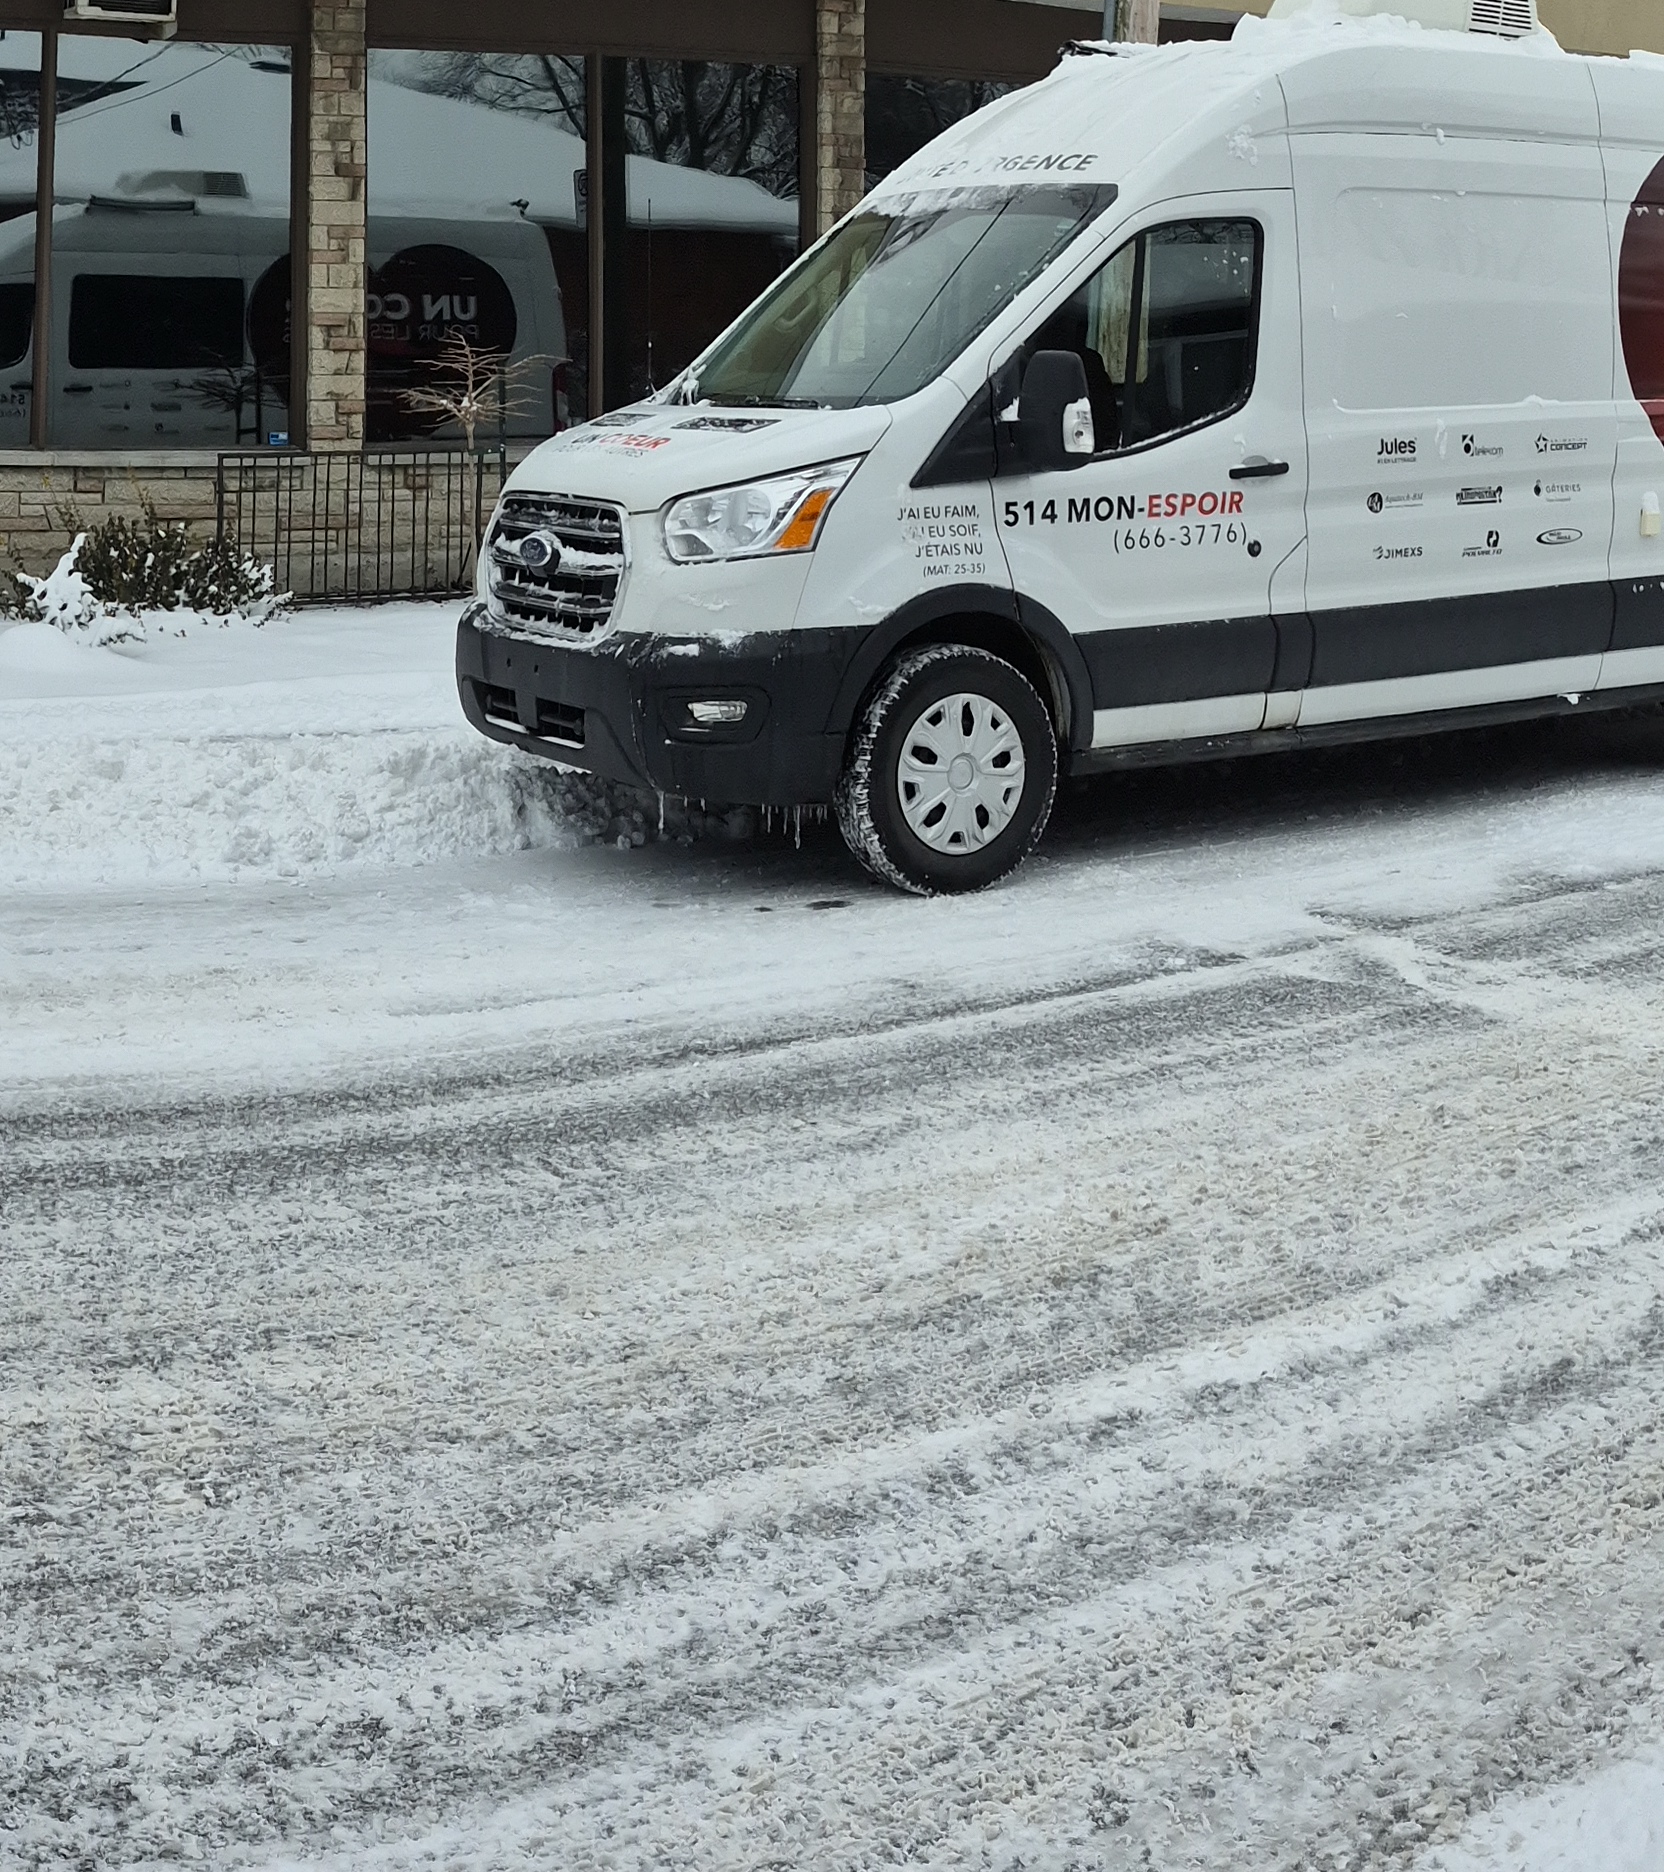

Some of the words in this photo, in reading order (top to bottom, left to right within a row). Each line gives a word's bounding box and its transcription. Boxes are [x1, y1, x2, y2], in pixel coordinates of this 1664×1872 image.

[1377, 437, 1416, 455] Jules
[897, 507, 920, 521] J'AI
[923, 506, 941, 519] EU
[944, 504, 980, 519] FAIM,
[1004, 499, 1058, 528] 514
[1068, 490, 1244, 523] MON-ESPOIR
[928, 525, 946, 538] EU
[948, 523, 981, 538] SOIF,
[1113, 522, 1248, 554] (666-3776)
[915, 542, 961, 558] J'ÉTAIS
[964, 542, 983, 555] NU
[954, 562, 986, 575] 25-35)
